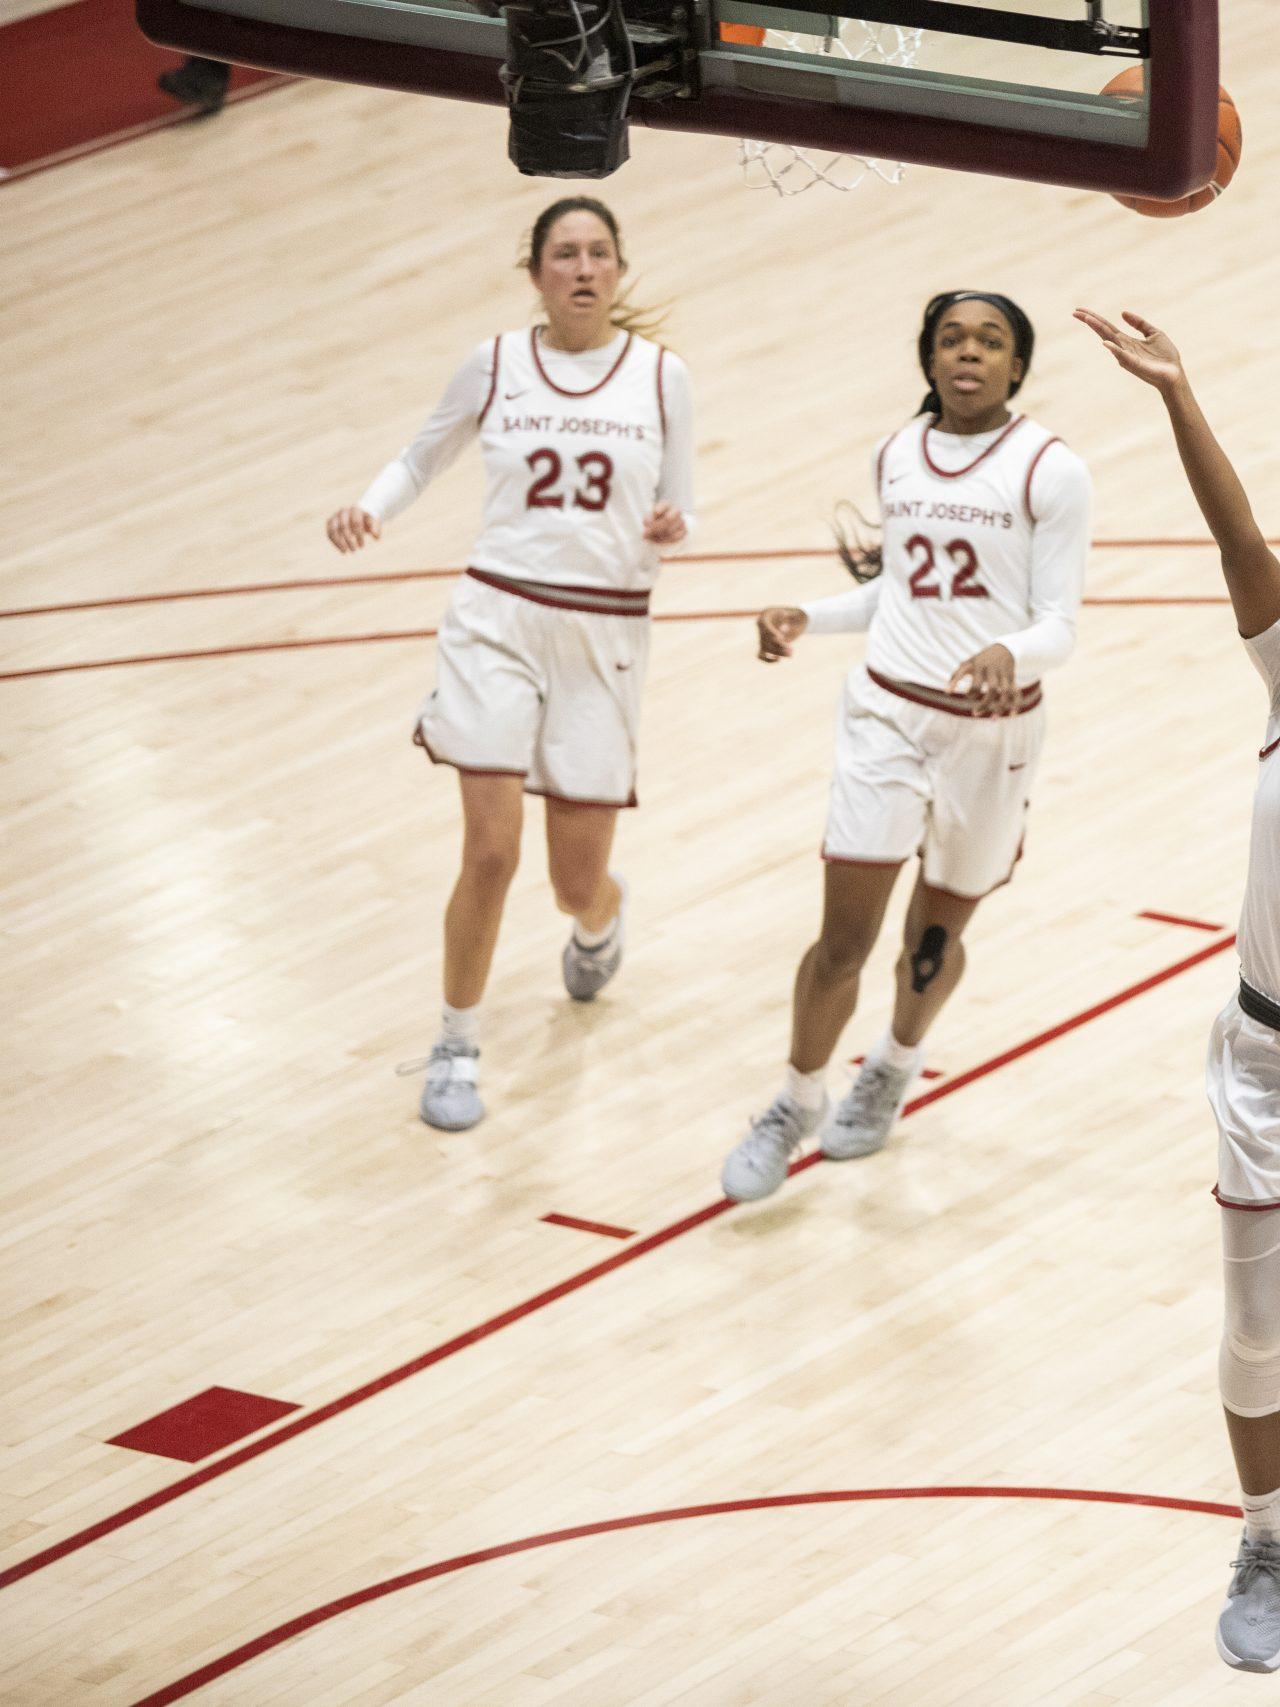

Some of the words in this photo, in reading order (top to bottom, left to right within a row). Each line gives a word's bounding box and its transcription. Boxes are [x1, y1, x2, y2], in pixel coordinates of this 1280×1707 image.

[502, 416, 553, 434] SAINT
[557, 416, 647, 441] JOSEPH'S
[524, 447, 615, 512] 23
[926, 503, 1014, 530] JOSEPH'S
[904, 533, 991, 600] 22
